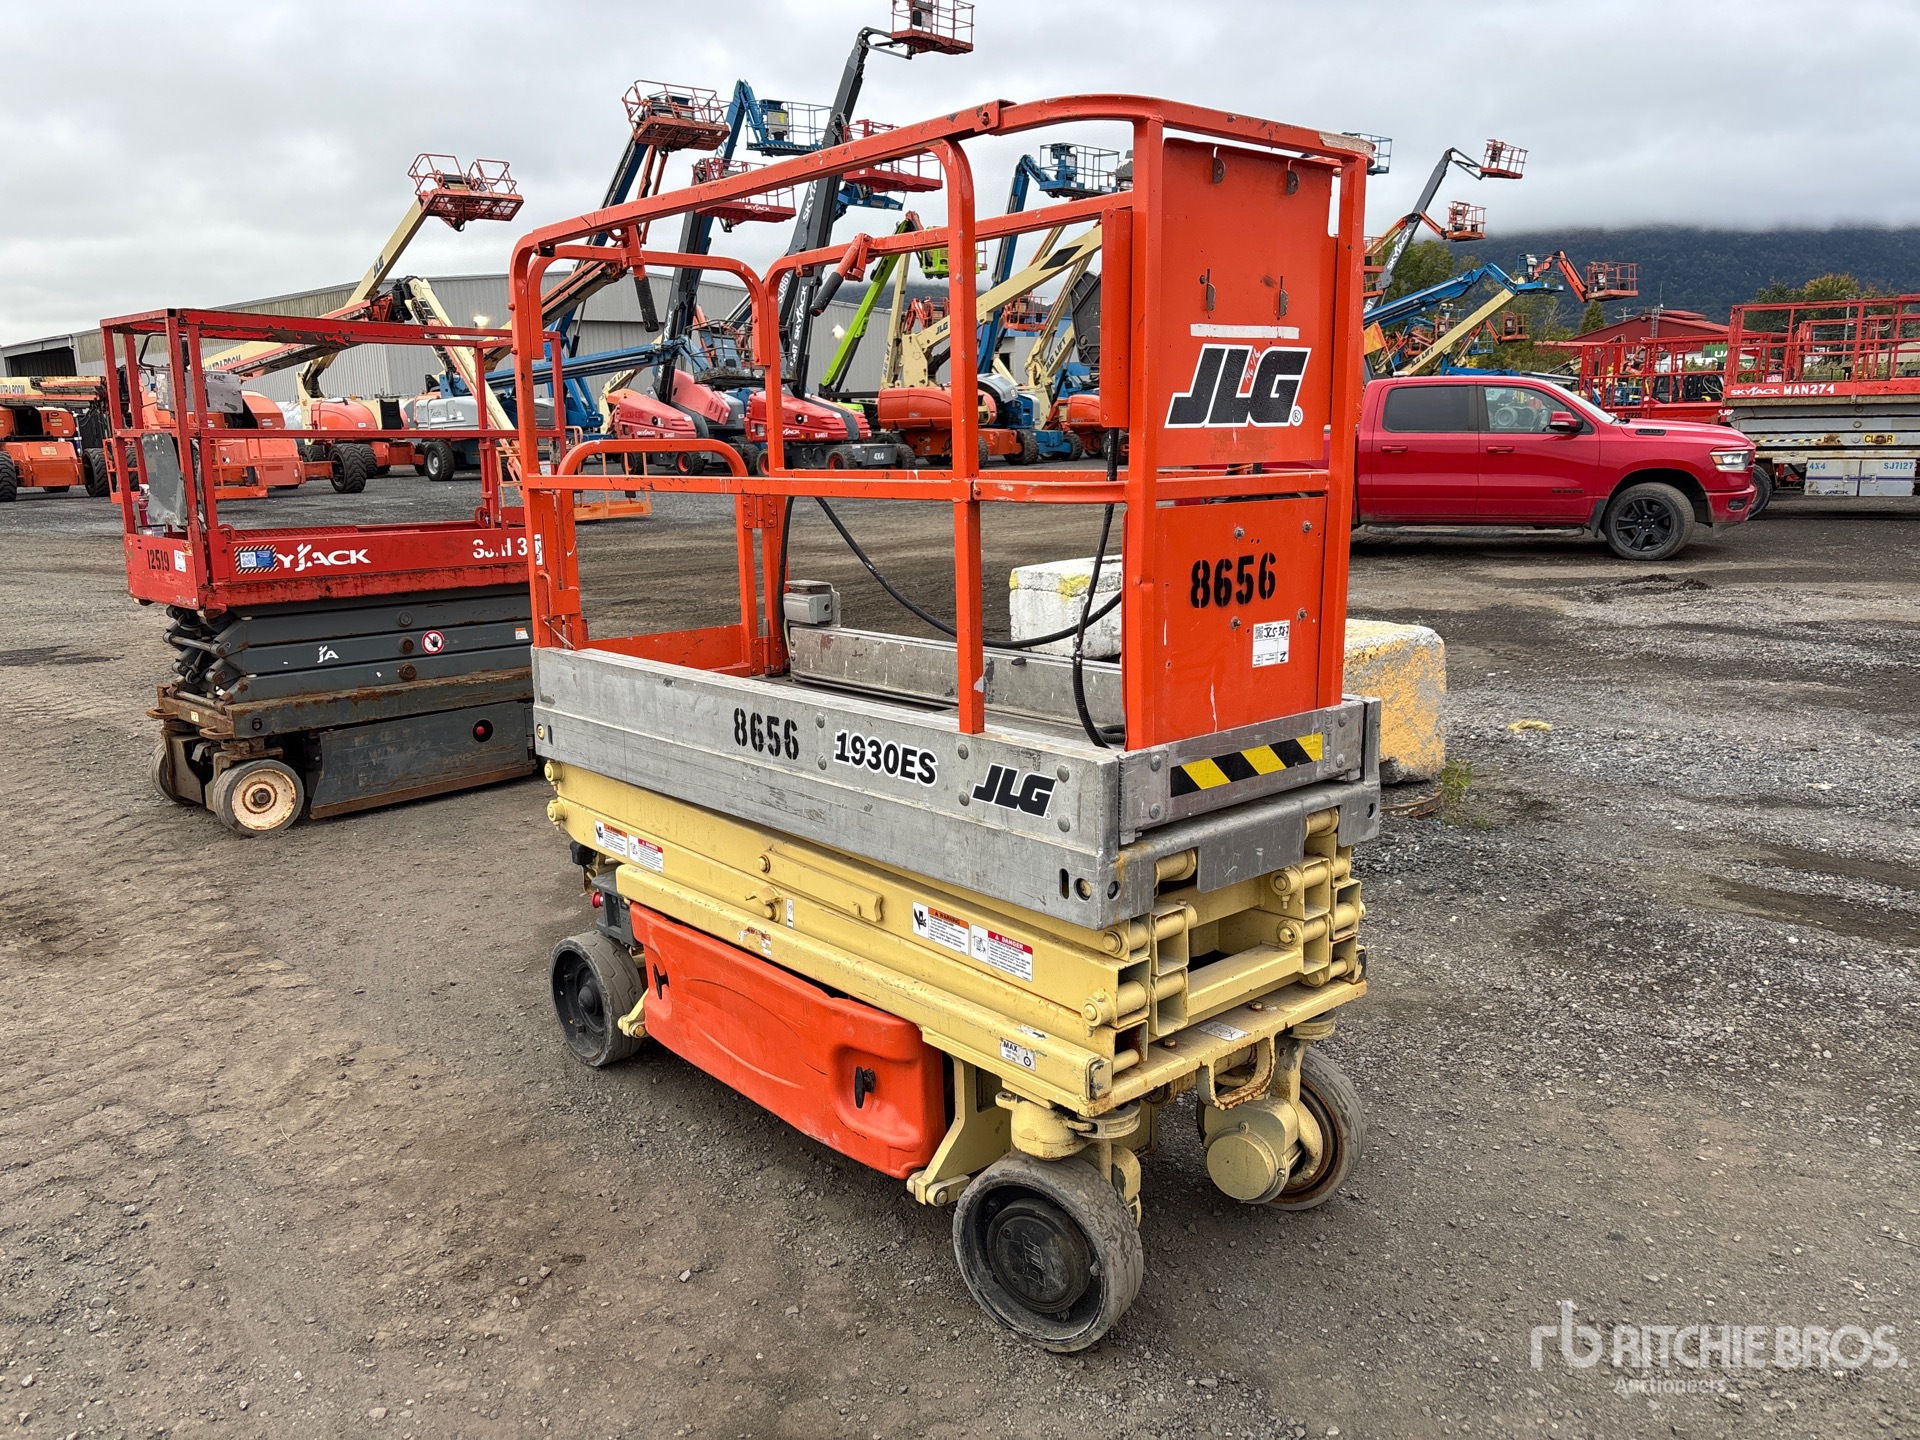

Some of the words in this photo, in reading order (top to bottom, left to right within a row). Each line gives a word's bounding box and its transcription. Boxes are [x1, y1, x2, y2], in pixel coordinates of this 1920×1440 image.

[1387, 228, 1412, 270] SKYJACK
[373, 254, 385, 279] JLG
[794, 285, 808, 341] SKYJACK
[936, 321, 949, 335] JLG
[1046, 355, 1056, 372] JLG
[1054, 336, 1067, 357] LIFT
[1420, 346, 1434, 360] LIFT
[1164, 343, 1312, 429] JLG
[1730, 386, 1780, 396] SKYJACK
[1783, 383, 1835, 395] MAN274
[1864, 434, 1894, 444] CLR
[873, 452, 885, 461] 4X4
[1809, 462, 1826, 470] 4X4
[1883, 461, 1914, 470] SJ7127
[146, 549, 170, 572] 12519
[277, 543, 372, 572] YJACK
[1190, 551, 1277, 609] 8656
[733, 706, 799, 760] 8656
[833, 730, 938, 786] 1930ES
[972, 763, 1057, 819] JLG
[939, 912, 961, 926] WARNING
[1001, 935, 1024, 951] DANGER
[1003, 1040, 1019, 1053] MAX
